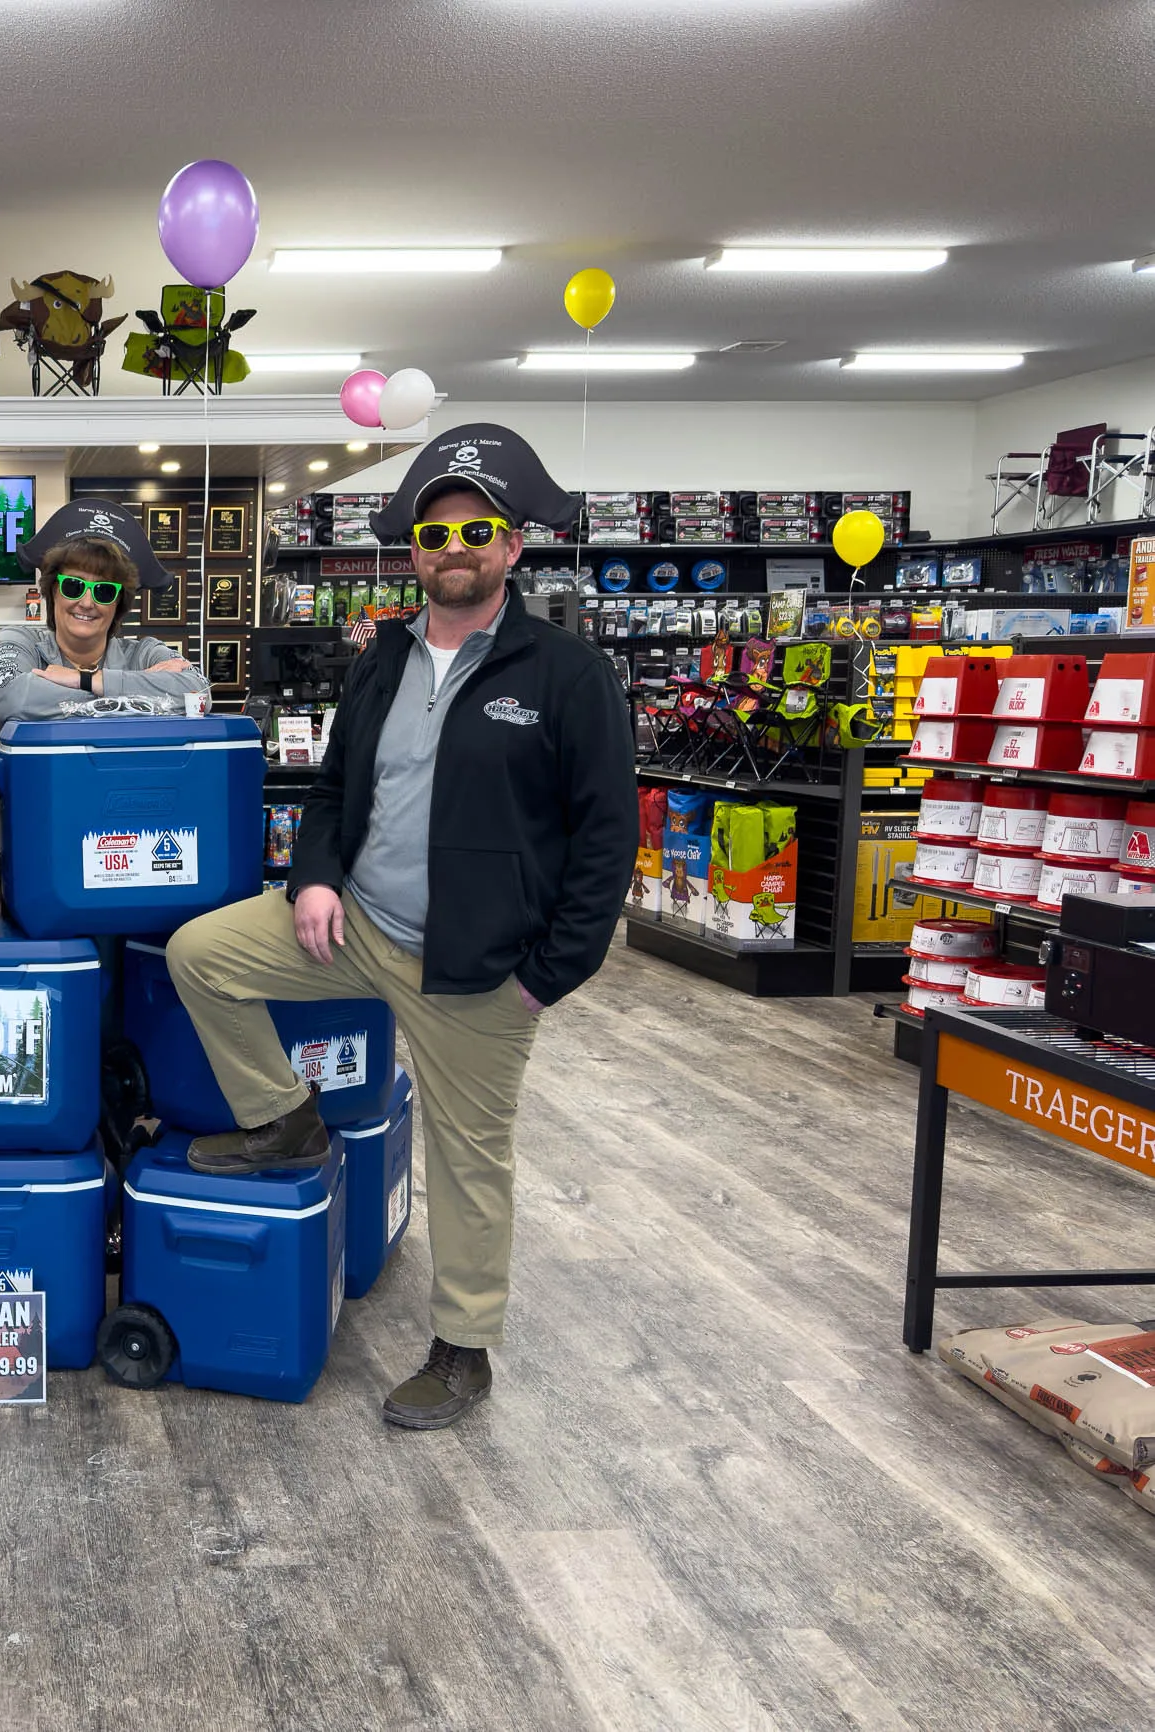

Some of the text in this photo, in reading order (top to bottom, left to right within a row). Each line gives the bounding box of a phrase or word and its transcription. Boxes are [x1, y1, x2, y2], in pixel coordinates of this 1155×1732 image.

[1034, 544, 1090, 560] FRESH WATER
[334, 561, 412, 572] SANITATION
[1016, 691, 1023, 700] EZ
[1008, 701, 1025, 710] BLOCK
[99, 838, 129, 848] Coleman
[163, 838, 171, 852] 5
[687, 849, 702, 860] Chair
[105, 854, 129, 870] USA
[345, 1043, 350, 1055] 5
[306, 1061, 321, 1078] USA
[1006, 1069, 1155, 1163] TRAEGER
[0, 1278, 6, 1292] 5
